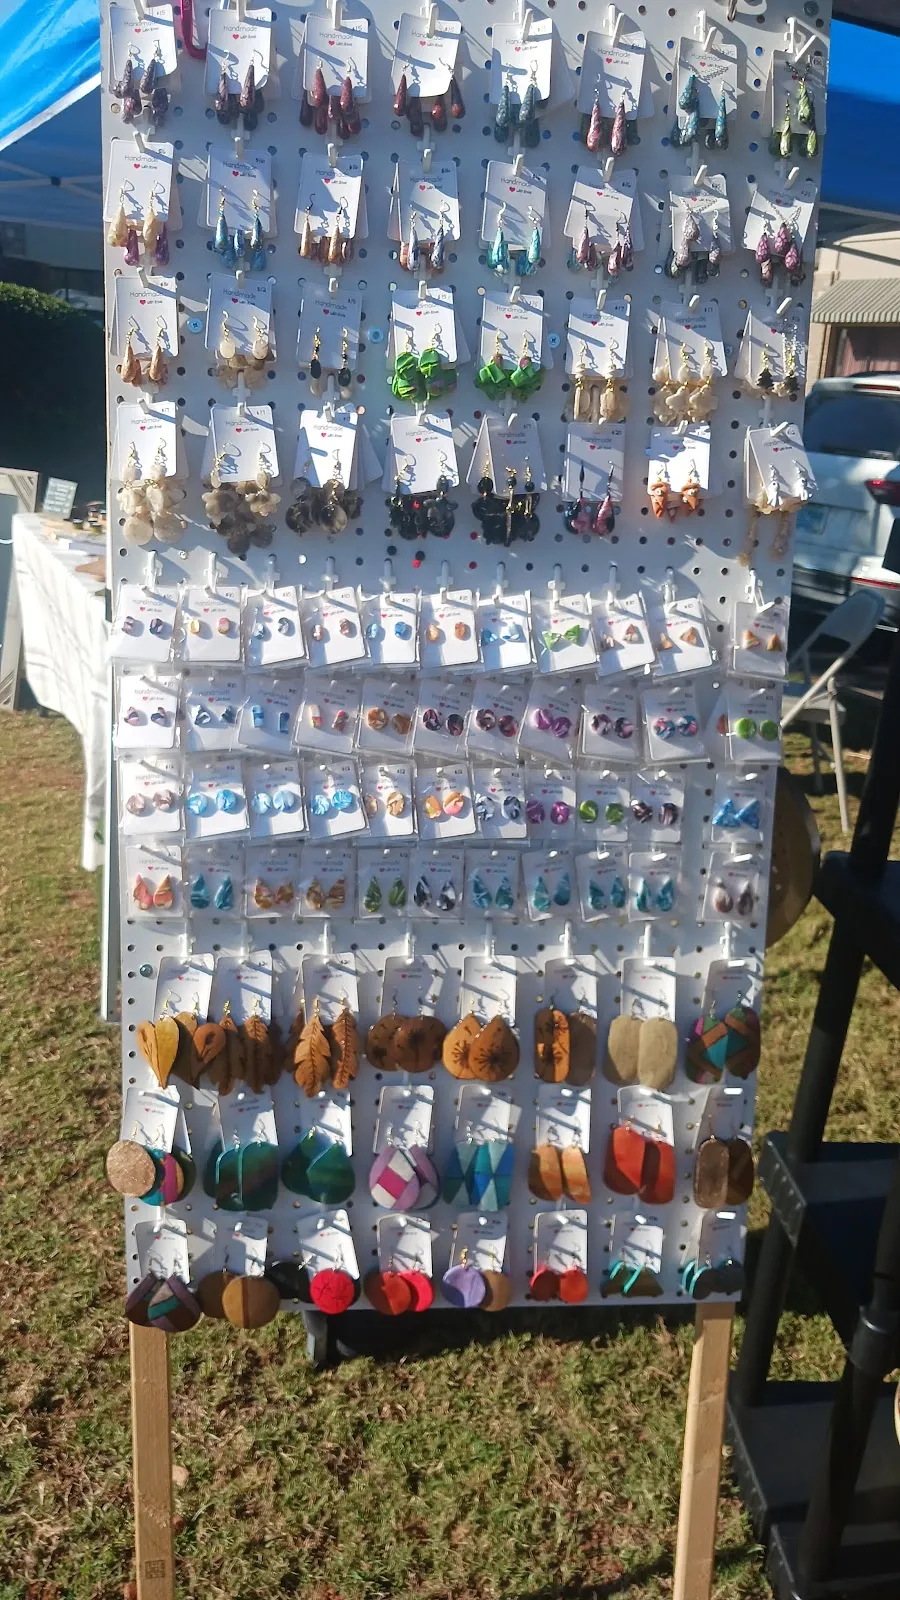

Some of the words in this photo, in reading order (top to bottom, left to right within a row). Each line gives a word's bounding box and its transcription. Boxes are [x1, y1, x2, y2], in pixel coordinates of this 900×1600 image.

[598, 49, 631, 58] Handmade
[223, 288, 256, 299] Handmade
[315, 300, 347, 310] Handmade
